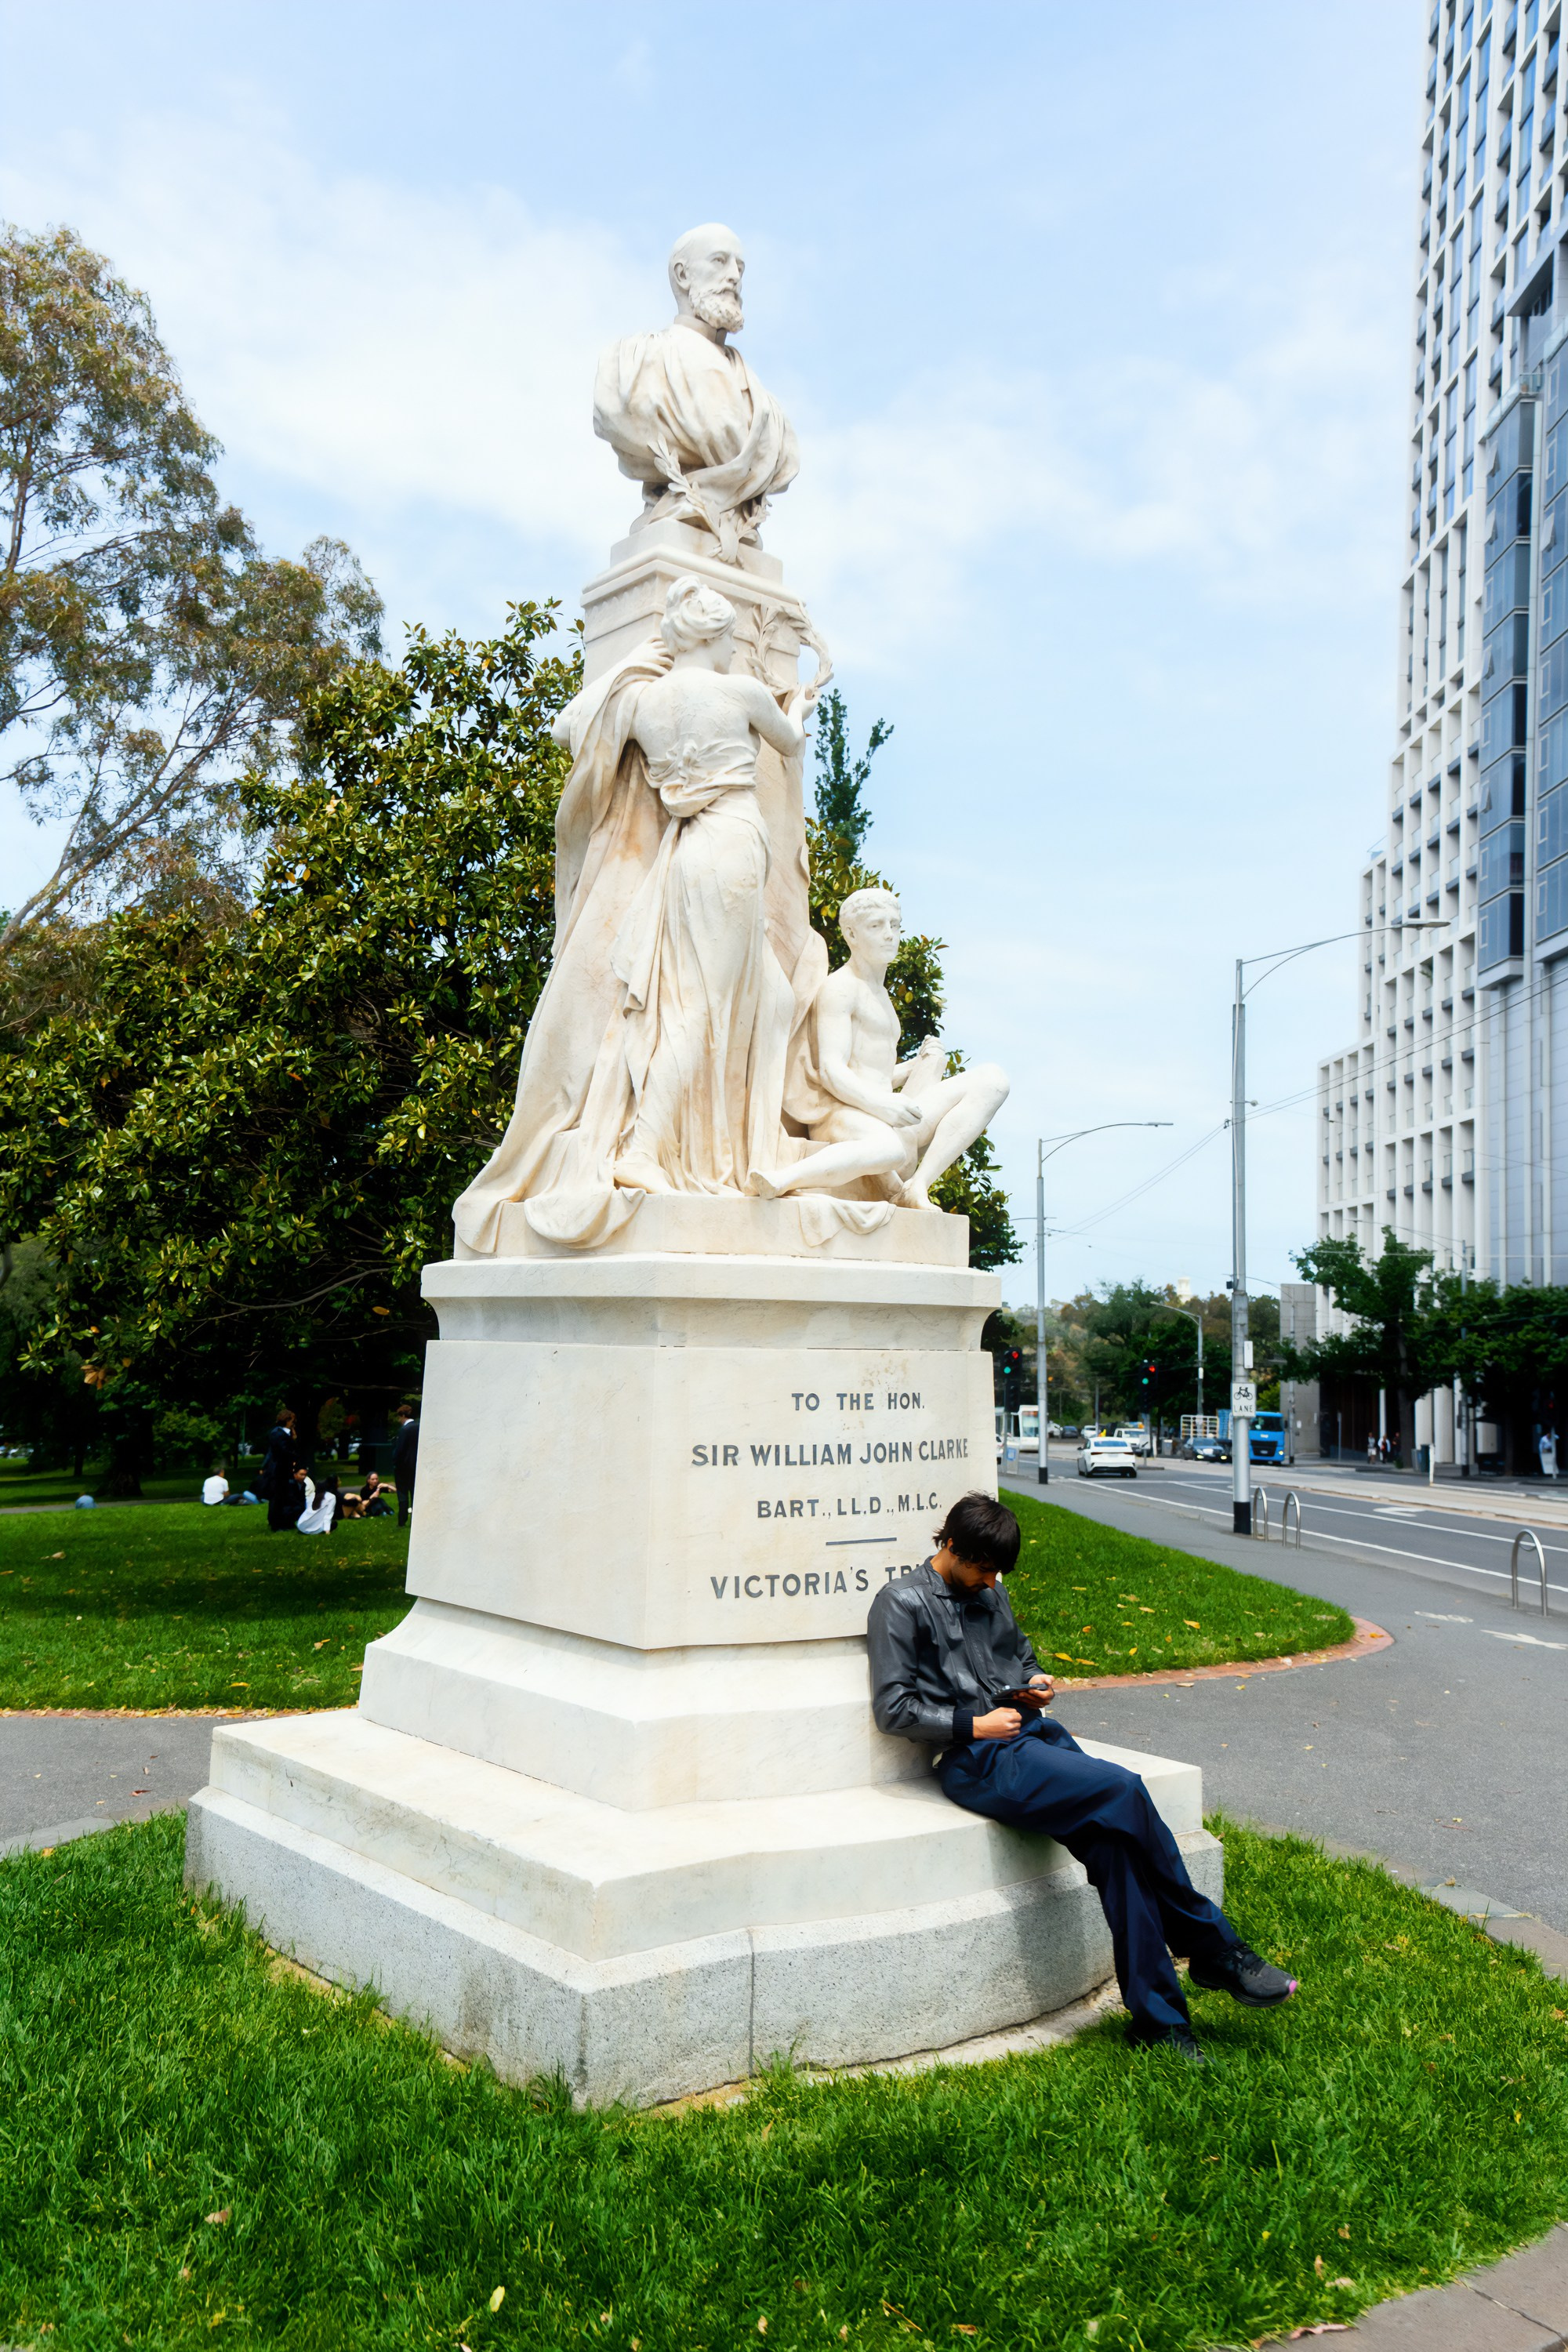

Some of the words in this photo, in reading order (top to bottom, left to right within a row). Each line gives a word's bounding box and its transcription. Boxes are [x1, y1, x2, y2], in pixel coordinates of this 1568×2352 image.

[791, 1392, 820, 1411] TO
[836, 1392, 874, 1410] THE
[887, 1392, 925, 1410] HON.
[1233, 1404, 1253, 1413] LANE
[691, 1444, 739, 1467] SIR
[750, 1443, 851, 1467] WILLIAM
[859, 1441, 913, 1465] JOHN
[918, 1438, 968, 1461] CLARKE
[710, 1566, 869, 1599] VICTORIA'S
